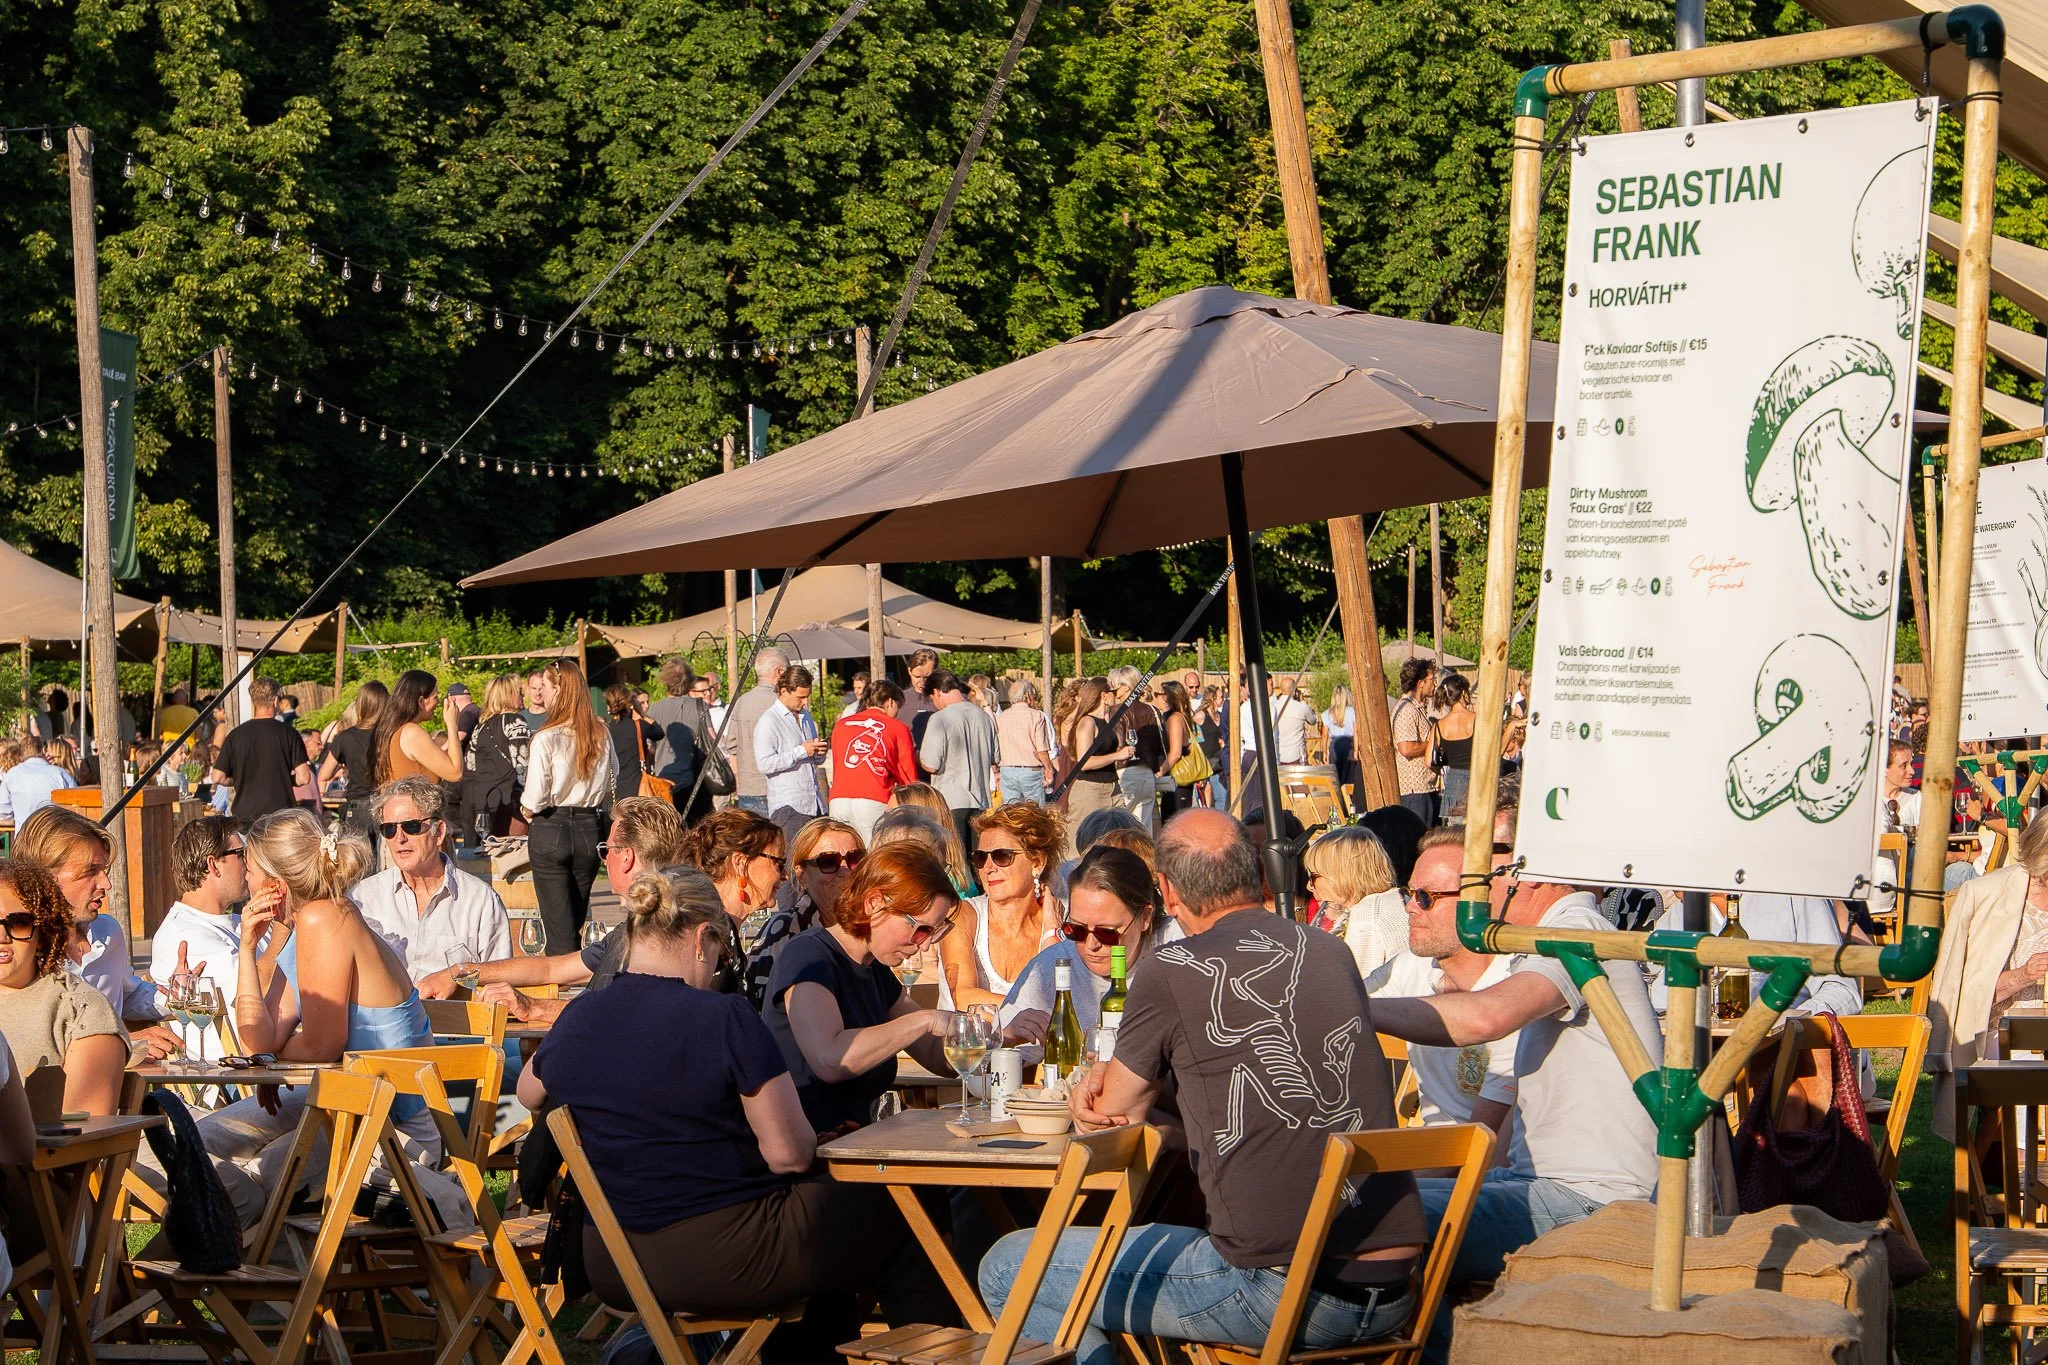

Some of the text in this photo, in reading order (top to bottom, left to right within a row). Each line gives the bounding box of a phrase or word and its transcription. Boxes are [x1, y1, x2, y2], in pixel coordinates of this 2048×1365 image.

[1596, 162, 1782, 215] SEBASTIAN
[1593, 220, 1701, 263] FRANK
[1607, 343, 1643, 355] Kaviaar
[1645, 340, 1678, 354] Softijs
[1689, 338, 1707, 351] €15
[1669, 356, 1686, 367] met
[1581, 373, 1673, 388] vegetarische kaviaar en
[1579, 391, 1603, 401] boter
[1570, 487, 1648, 500] Dirty Mushroom
[1636, 501, 1653, 513] €22
[1566, 534, 1579, 543] van
[1660, 534, 1670, 543] en
[1210, 561, 1235, 596] MAX TENTE
[1558, 645, 1578, 657] Vals
[1579, 645, 1625, 658] Gebraad
[1637, 646, 1654, 659] €14
[1557, 661, 1610, 673] Champignons
[1611, 663, 1628, 673] met
[1670, 664, 1681, 673] en
[1124, 670, 1154, 708] MAX TENTEN
[1554, 692, 1583, 701] schuim
[1583, 693, 1595, 701] van
[1596, 693, 1640, 705] aardappel
[1640, 694, 1651, 704] en
